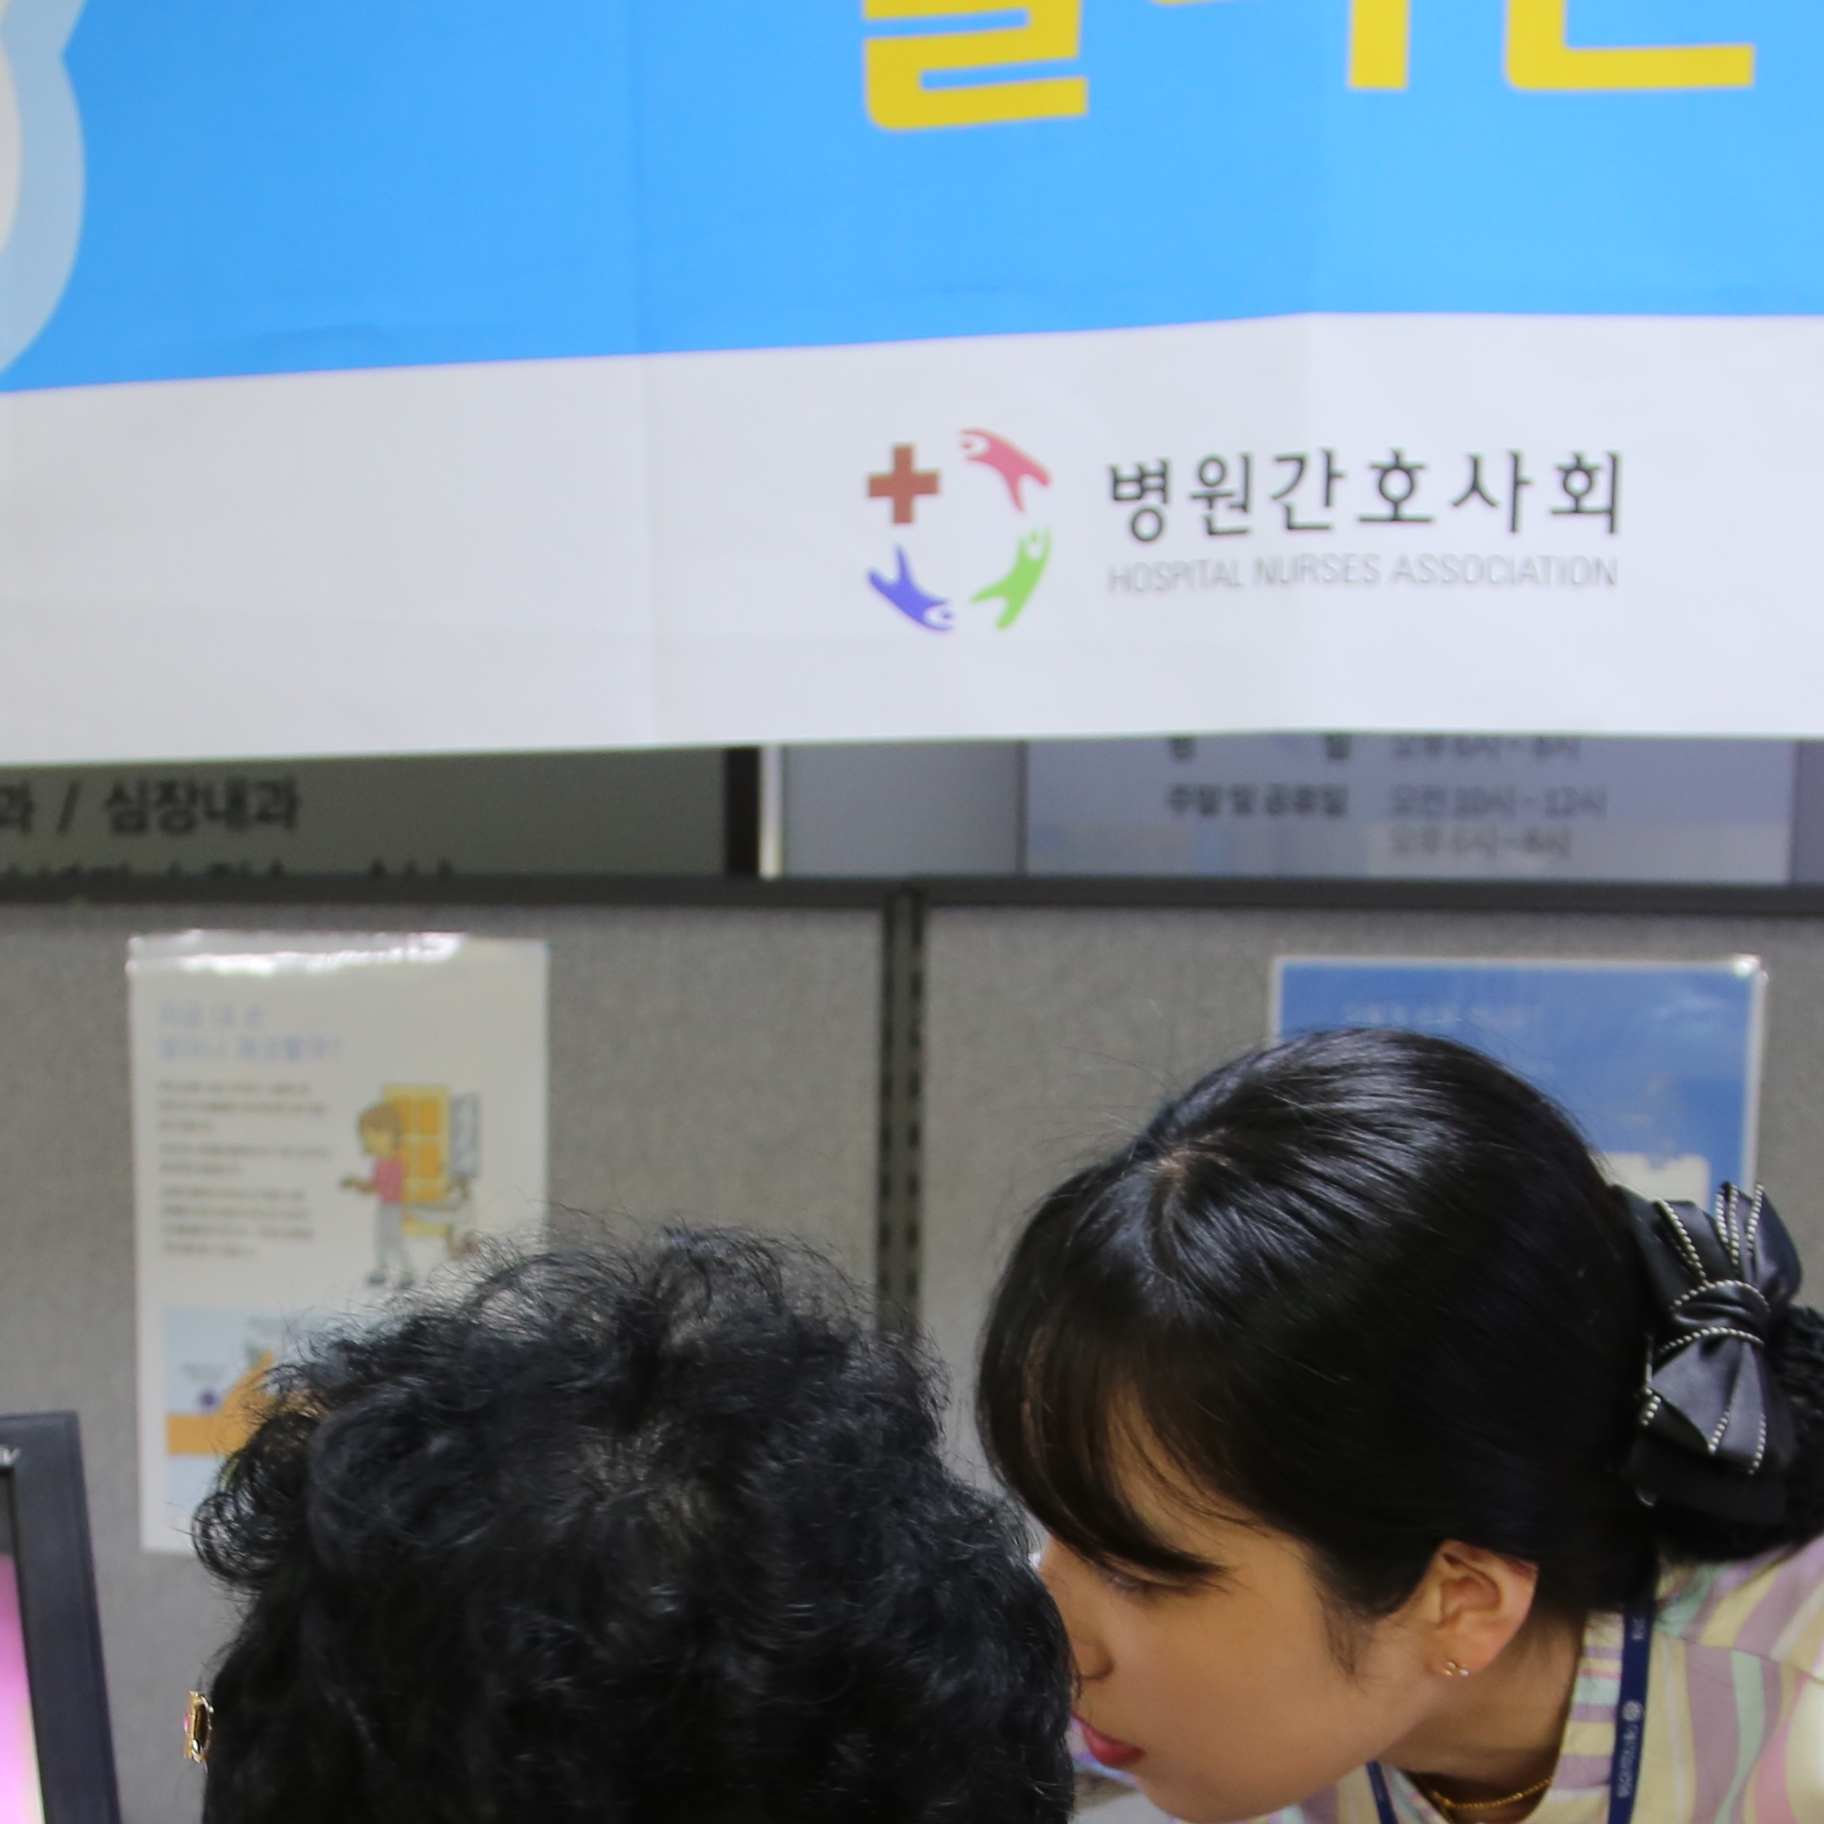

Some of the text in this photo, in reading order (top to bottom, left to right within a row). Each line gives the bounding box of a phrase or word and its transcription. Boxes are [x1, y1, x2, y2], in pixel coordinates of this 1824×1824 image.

[1107, 447, 1623, 543] 병원간호사회
[1107, 551, 1619, 595] HOSPITAL NURSES ASSOCIATION
[103, 775, 302, 838] 심장내과
